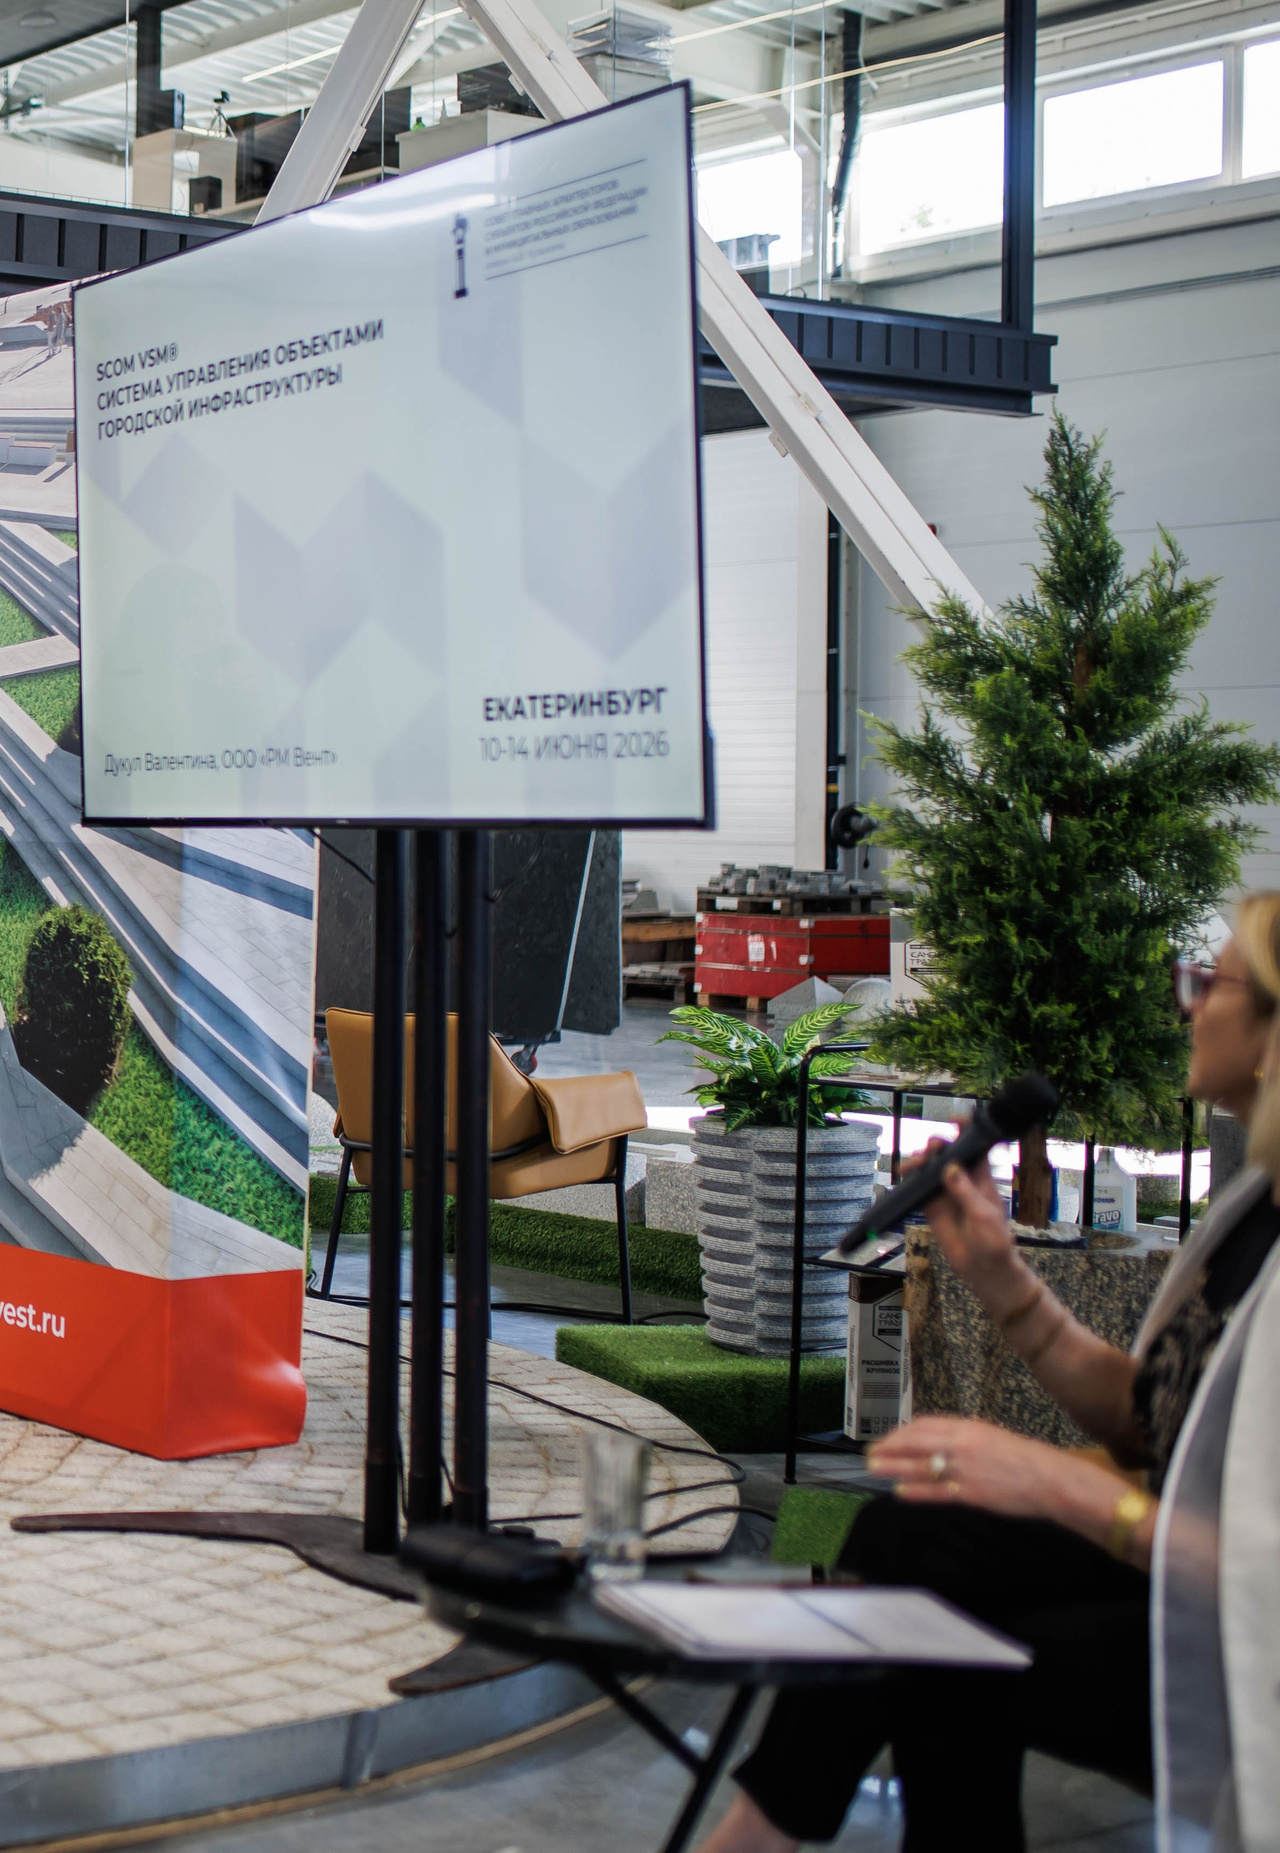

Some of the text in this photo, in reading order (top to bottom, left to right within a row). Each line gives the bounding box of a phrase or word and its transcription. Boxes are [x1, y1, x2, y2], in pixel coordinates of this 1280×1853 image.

[97, 318, 384, 411] СИСТЕМА УПРАВЛЕНИЯ ОБЪЕКТАМИ
[97, 354, 136, 382] SCOM
[98, 363, 343, 440] ГОРОДСКОЙ ИНФРАСТРУКТУРЫ
[484, 687, 668, 721] ЕКАТЕРИНБУРГ
[221, 750, 257, 769] ООО
[479, 731, 670, 762] 10-14 ИЮНЯ 2026
